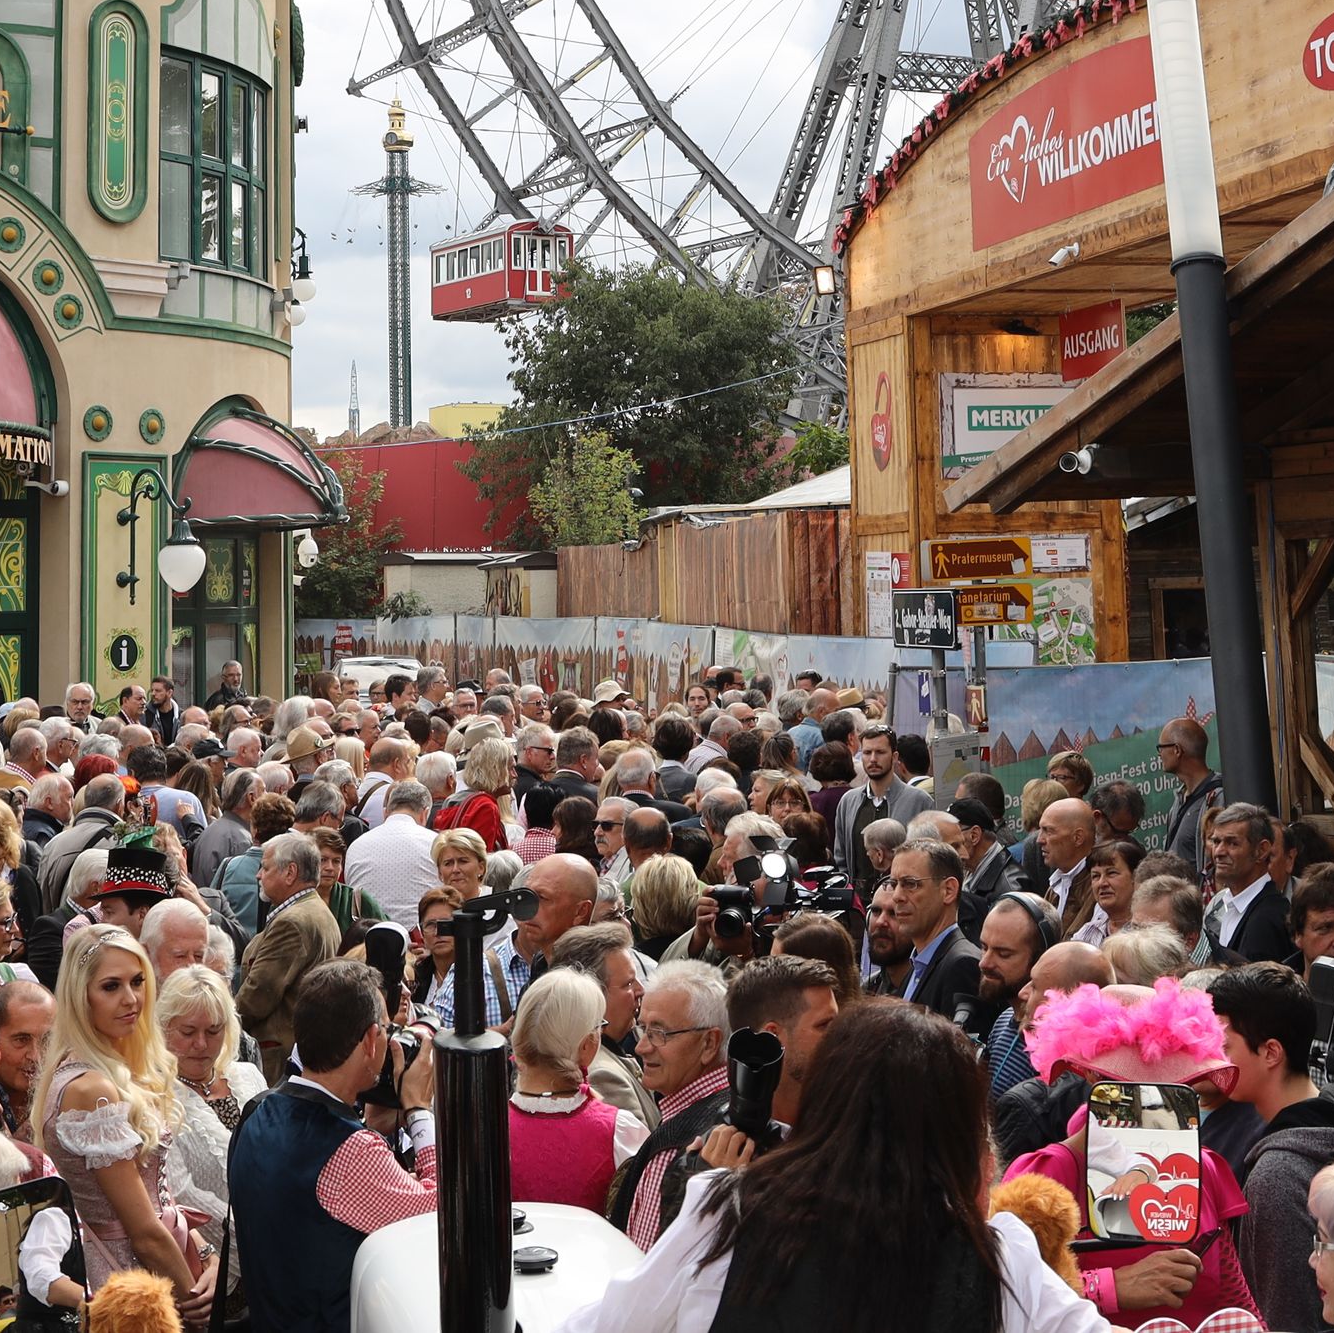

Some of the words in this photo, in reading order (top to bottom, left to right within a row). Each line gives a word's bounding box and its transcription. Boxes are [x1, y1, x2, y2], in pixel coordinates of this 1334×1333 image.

[1064, 324, 1119, 360] AUSGANG
[971, 408, 1048, 427] MERKU
[951, 552, 1015, 565] Pratermuseum
[956, 591, 1011, 603] lanetarium
[1093, 761, 1147, 787] iesn-Fest
